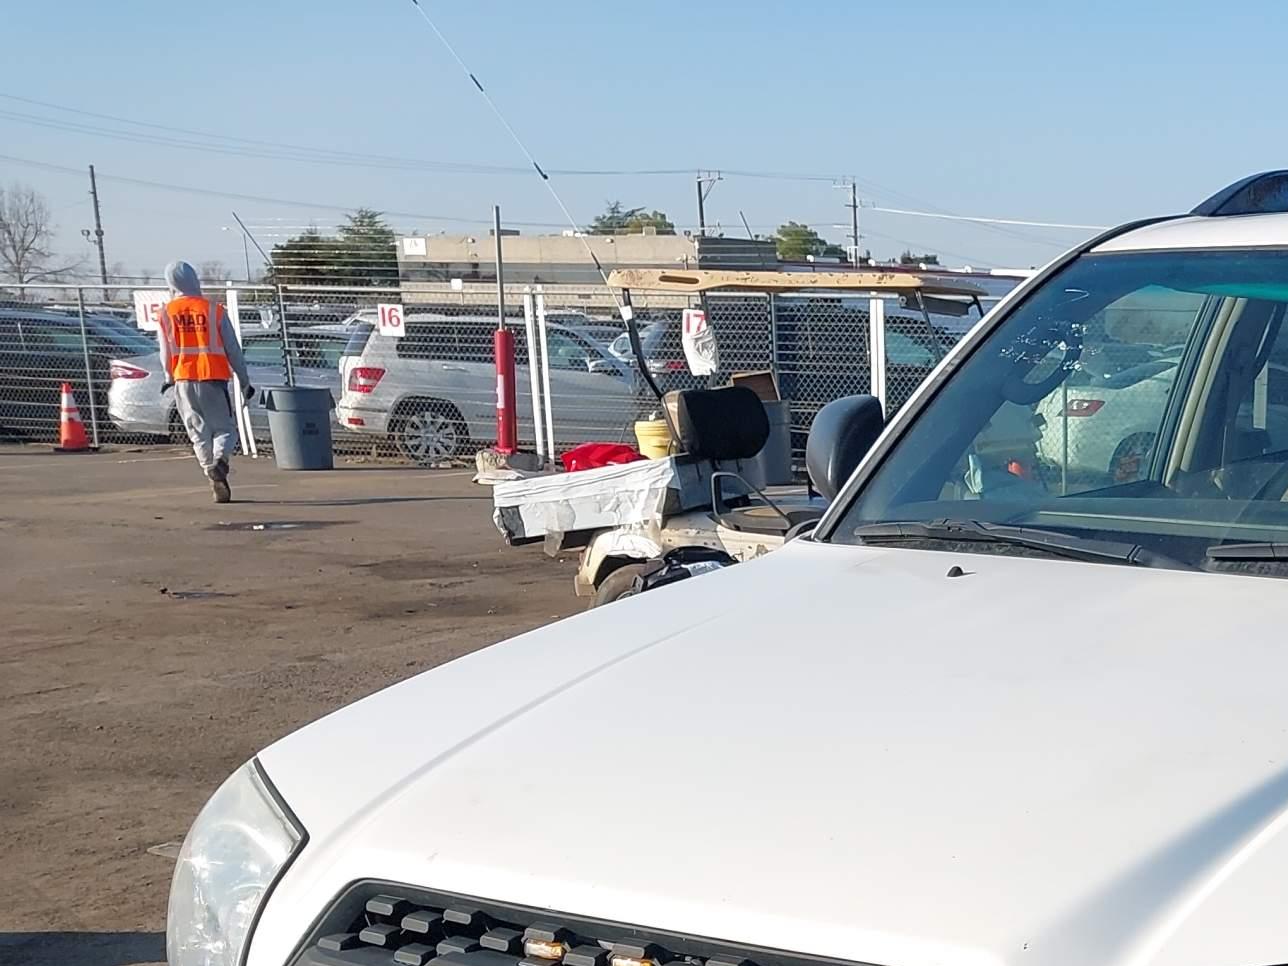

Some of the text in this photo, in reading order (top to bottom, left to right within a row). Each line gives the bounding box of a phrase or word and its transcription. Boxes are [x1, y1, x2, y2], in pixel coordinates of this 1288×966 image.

[143, 303, 160, 322] 15
[173, 313, 207, 327] MAD
[381, 306, 401, 328] 16
[686, 312, 706, 333] 17
